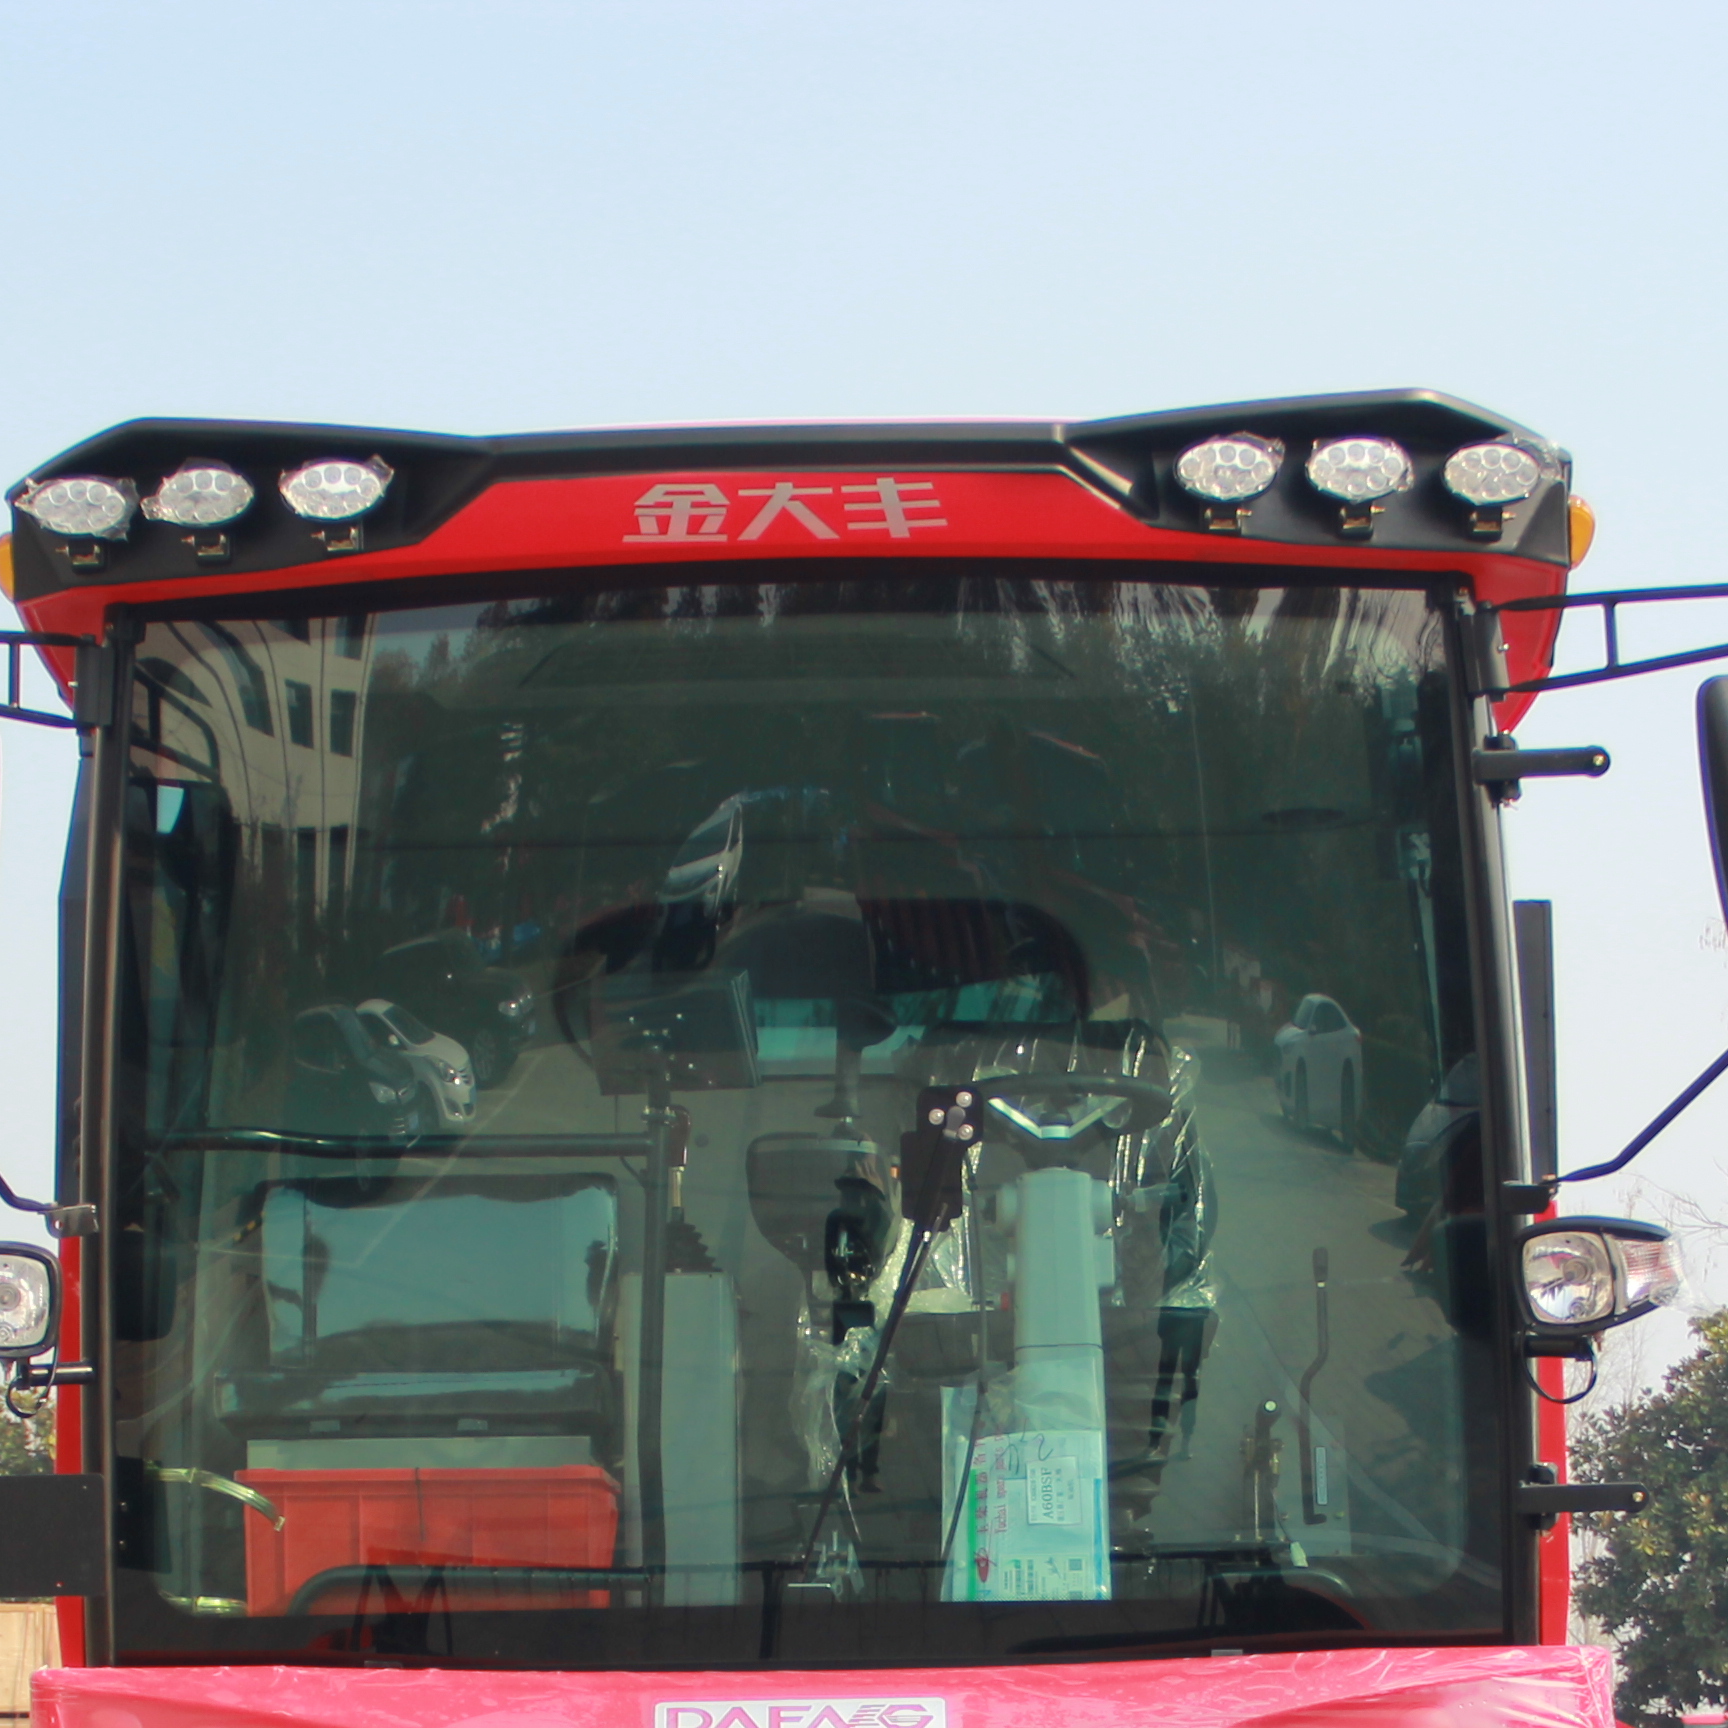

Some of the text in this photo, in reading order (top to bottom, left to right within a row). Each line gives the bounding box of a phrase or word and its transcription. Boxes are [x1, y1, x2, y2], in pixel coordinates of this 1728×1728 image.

[622, 477, 948, 543] 金大丰
[1040, 1467, 1054, 1520] A60BSF
